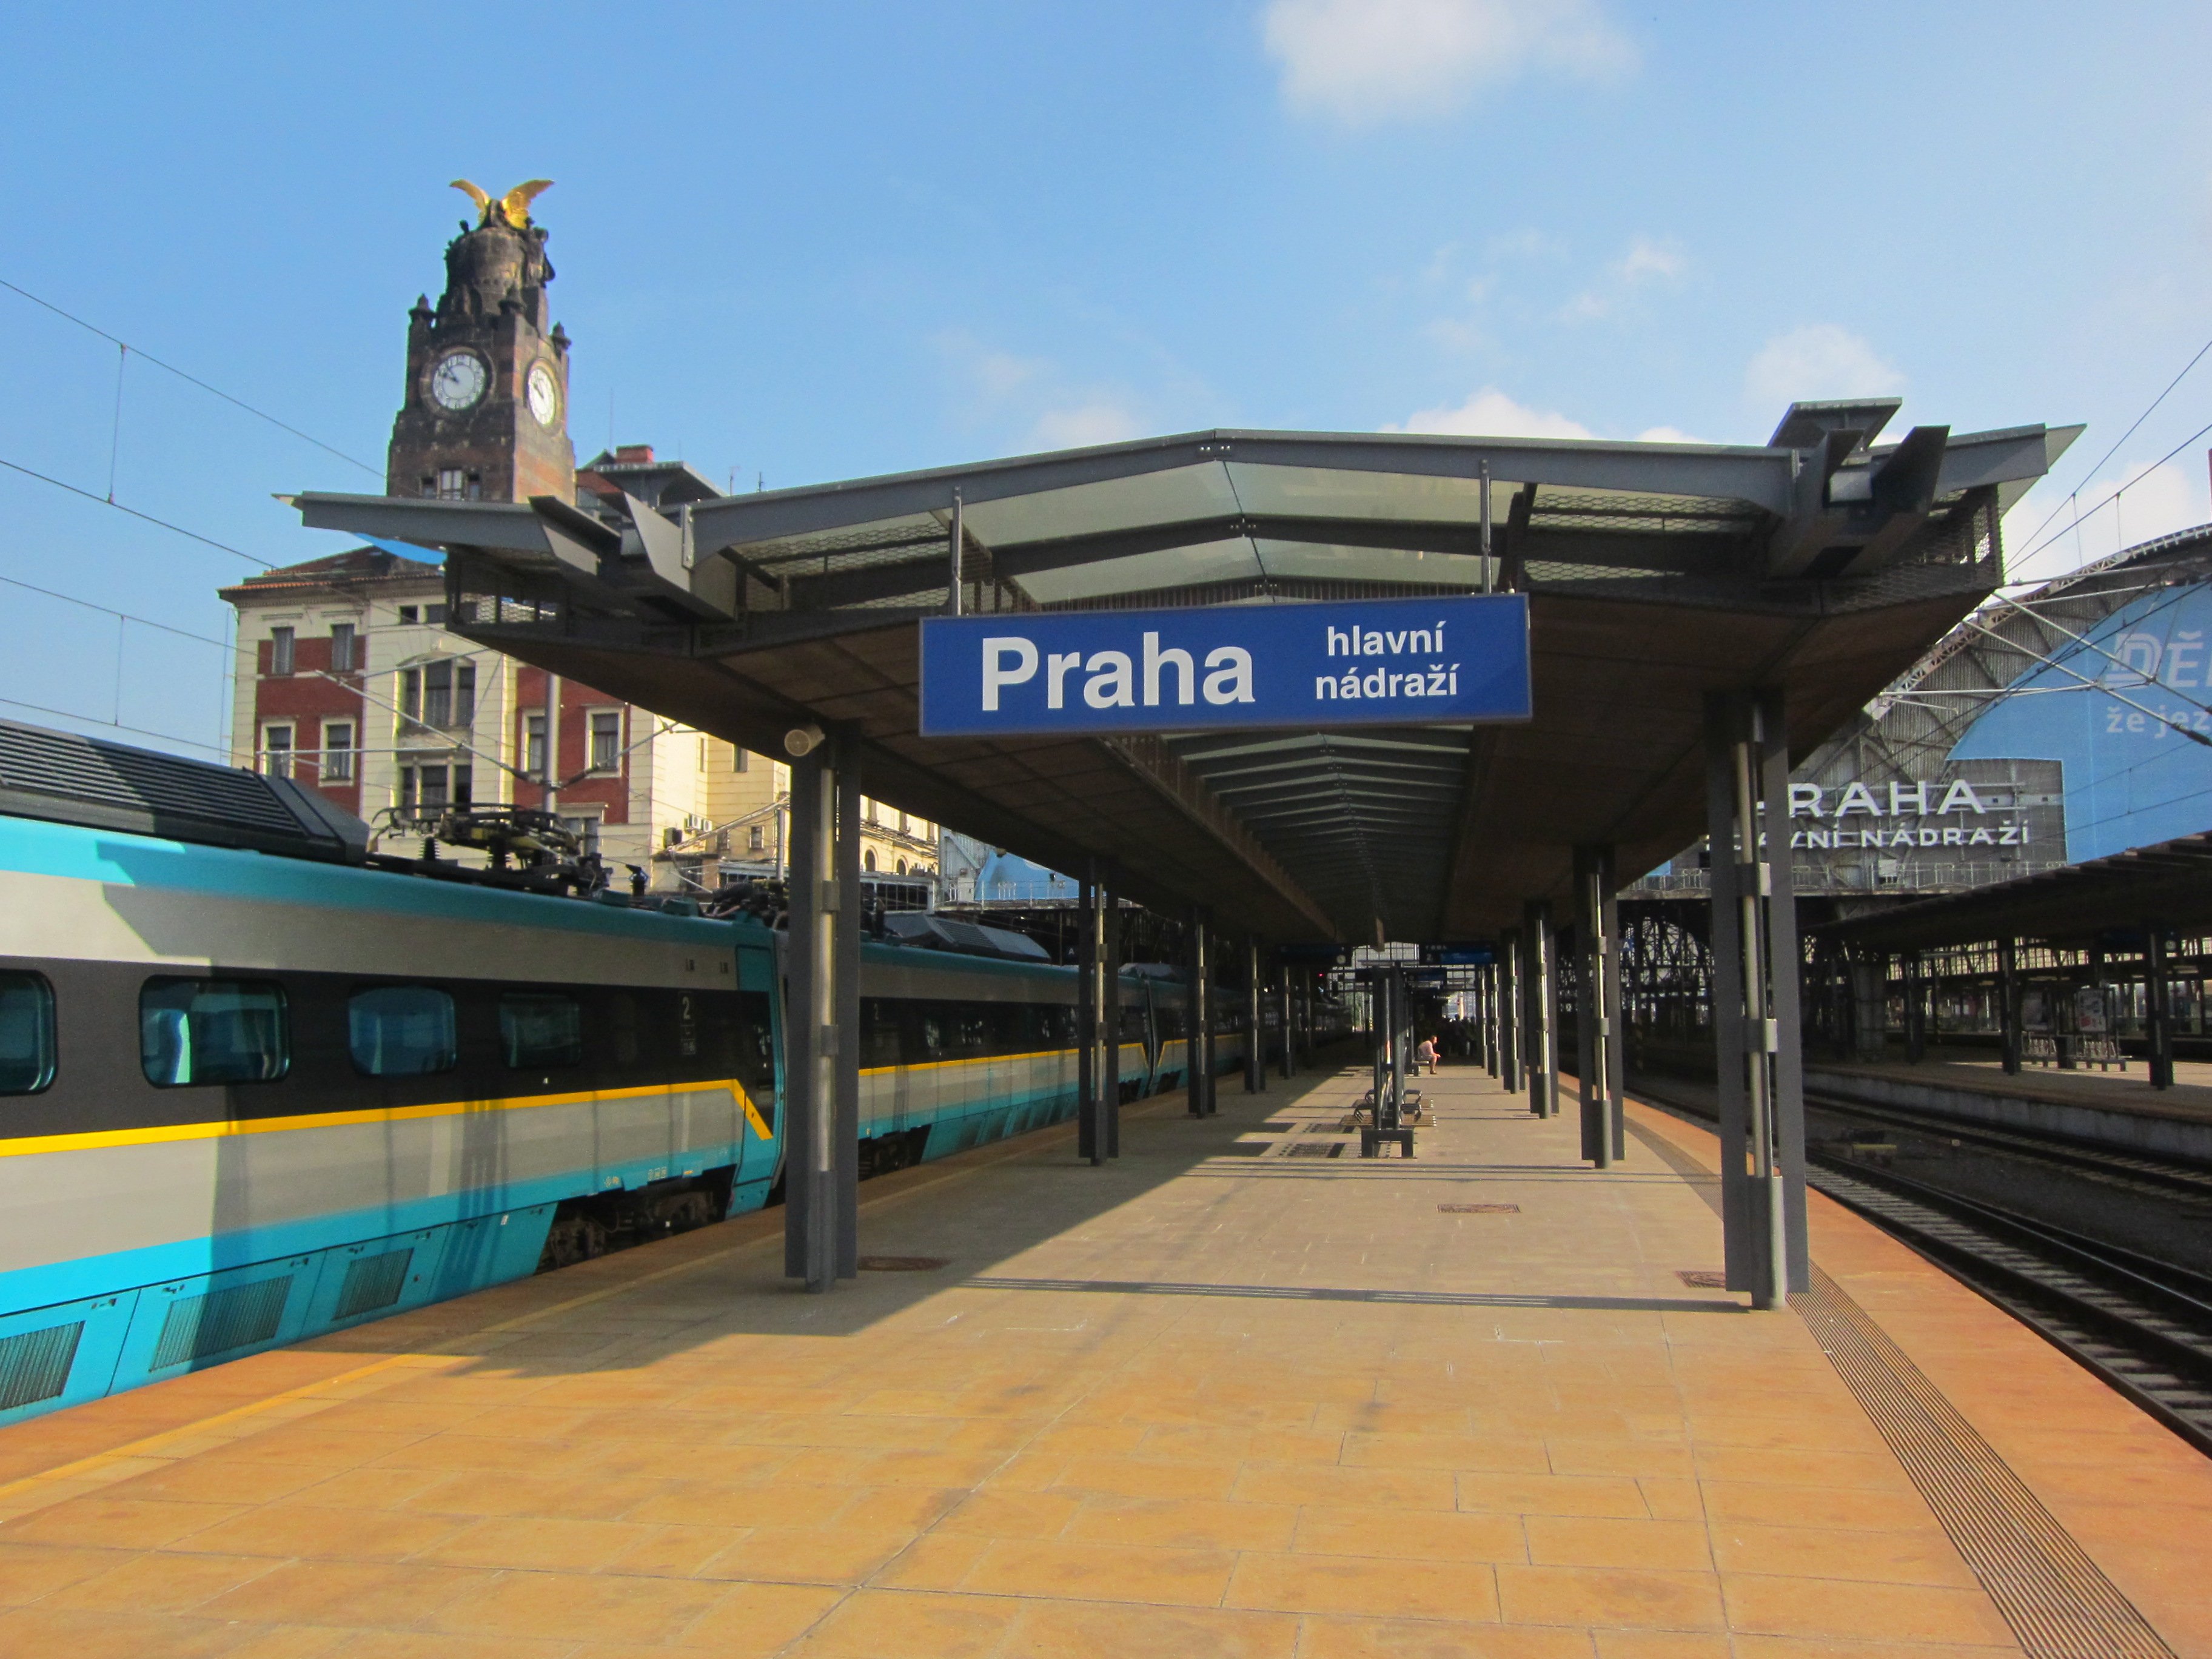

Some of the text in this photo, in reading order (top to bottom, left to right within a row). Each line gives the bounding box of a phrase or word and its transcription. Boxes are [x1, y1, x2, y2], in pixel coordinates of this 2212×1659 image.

[1328, 620, 1446, 656] hlavní
[982, 631, 1256, 711] Praha
[2105, 631, 2212, 690] DĚ
[1316, 663, 1460, 699] nádraží
[2106, 706, 2145, 732] že
[1757, 779, 1986, 818] RAHA
[1860, 819, 2029, 848] NÁDRAŽÍ
[682, 996, 691, 1019] 2
